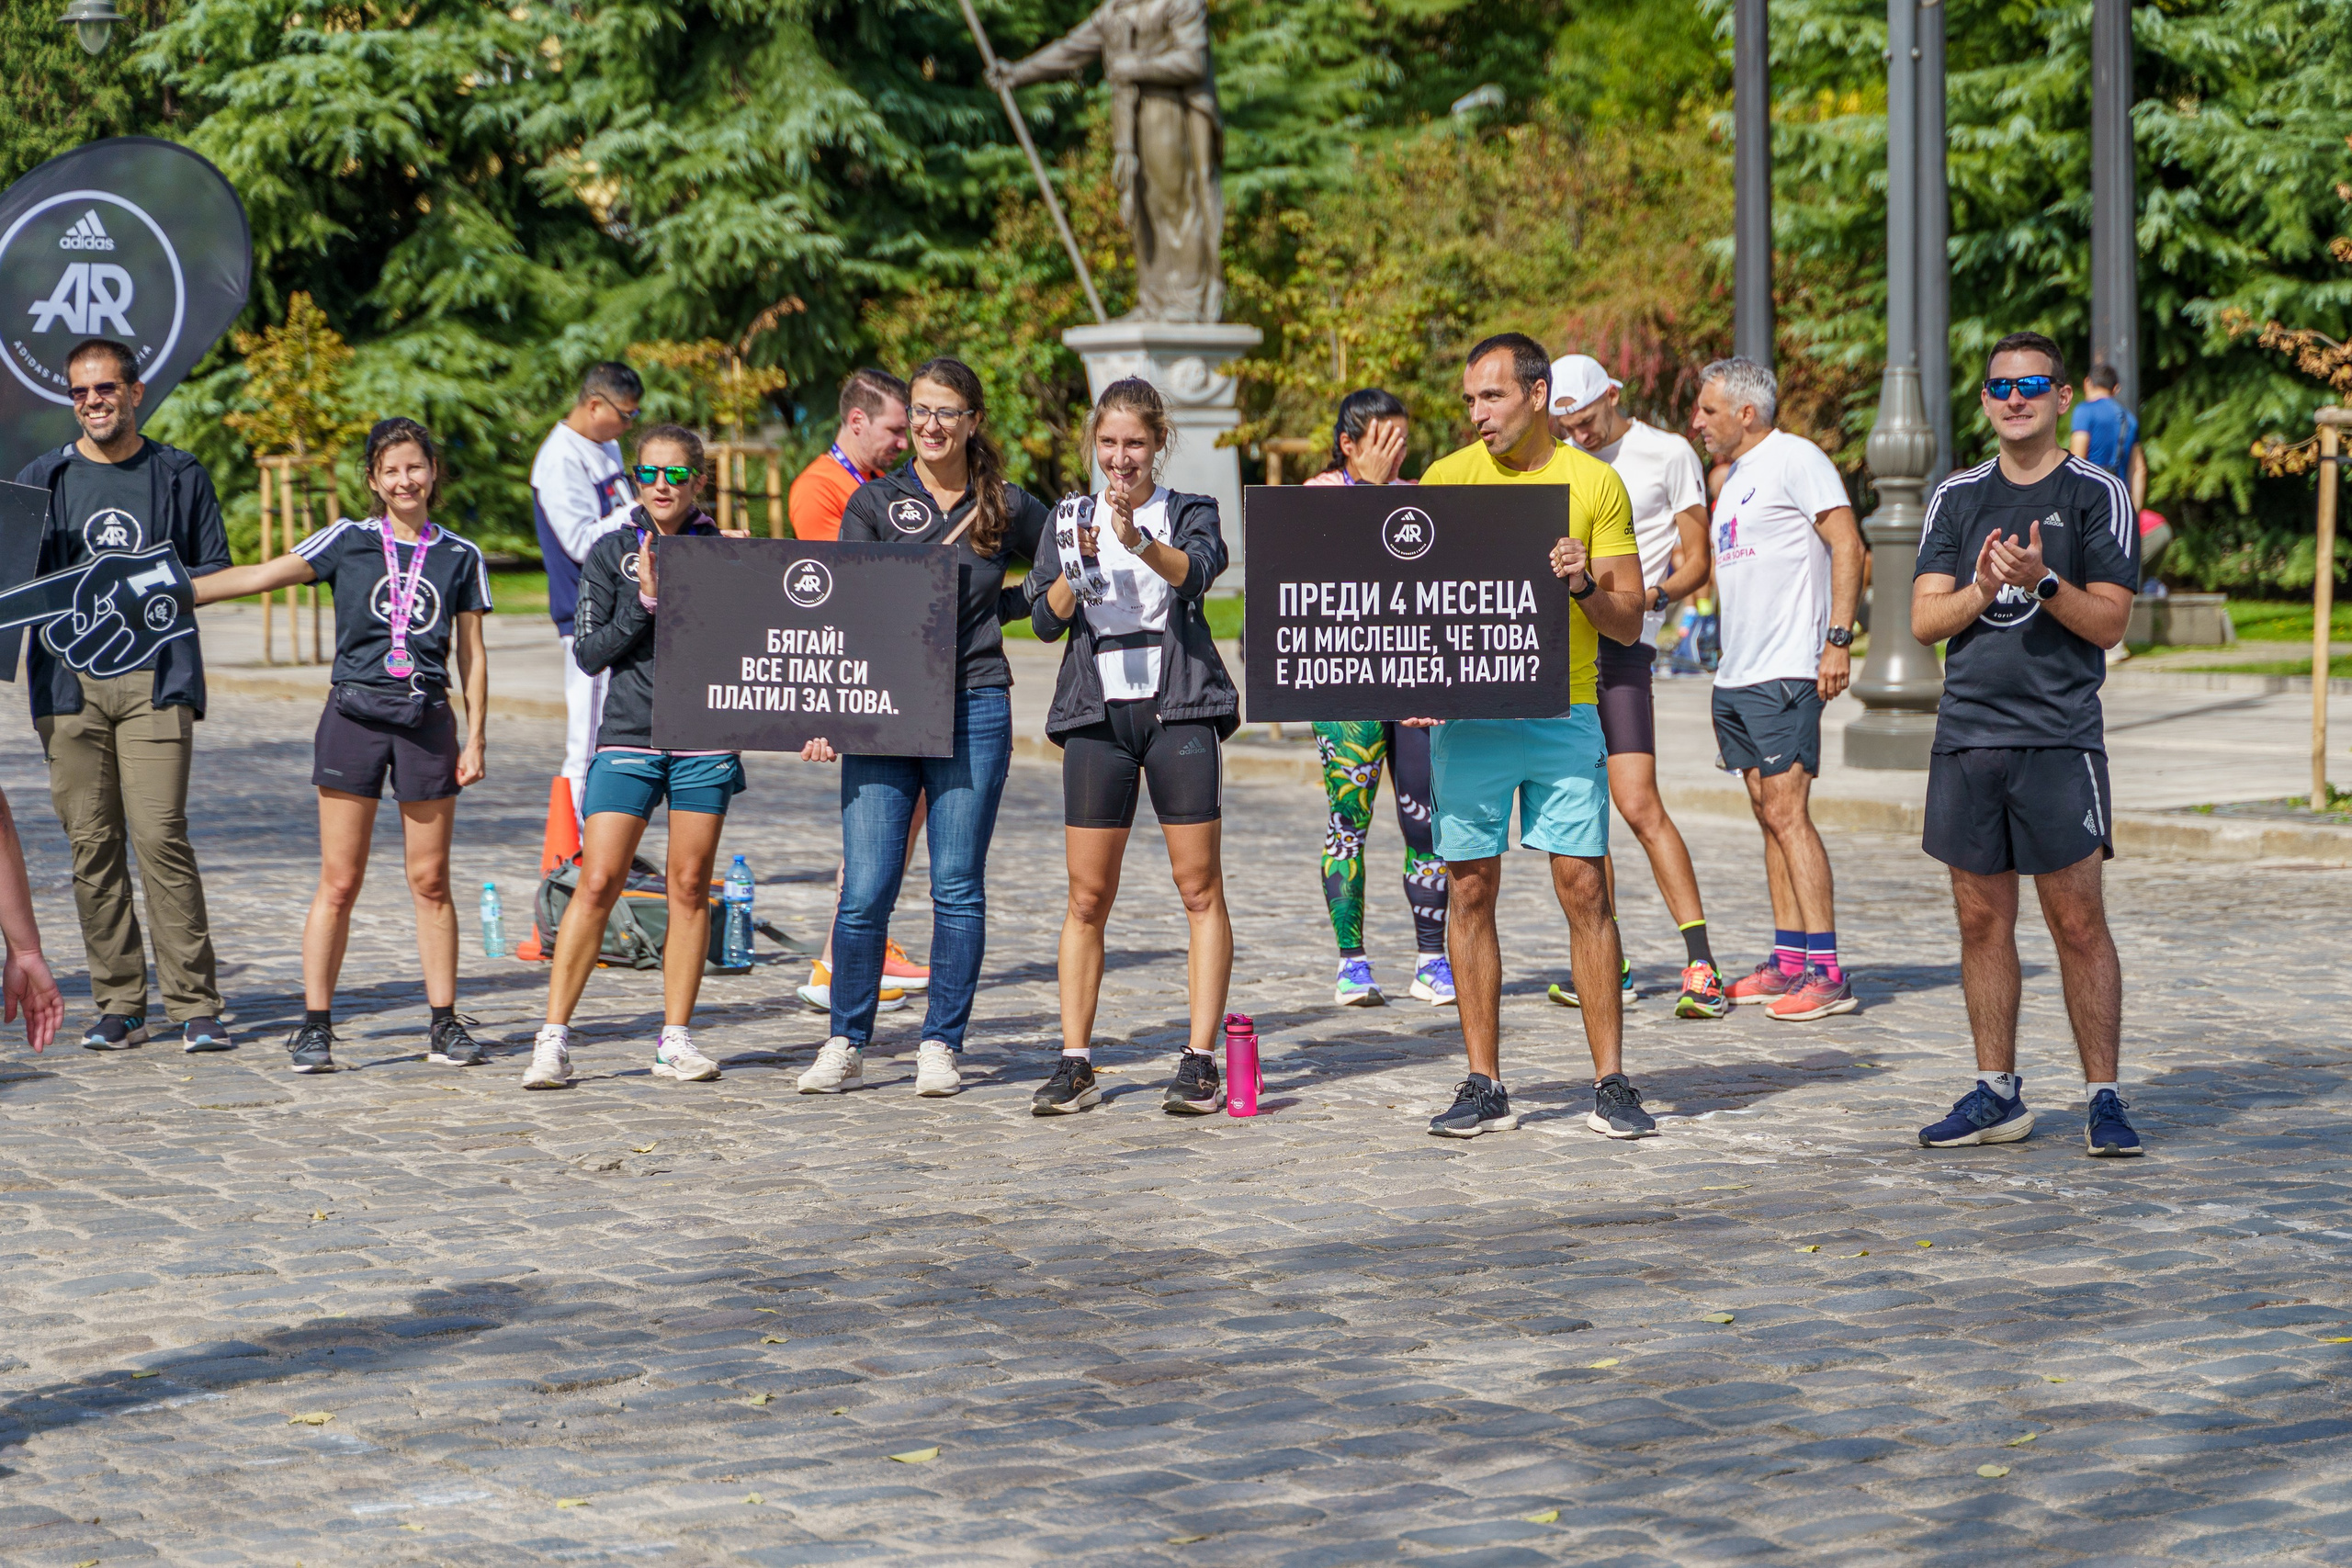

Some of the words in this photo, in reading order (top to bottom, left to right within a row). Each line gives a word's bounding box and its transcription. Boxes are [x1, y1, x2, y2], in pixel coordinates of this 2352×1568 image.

[59, 235, 115, 251] adidas
[28, 262, 135, 336] AR
[13, 340, 50, 378] ADIDAS
[96, 525, 129, 547] AR
[1393, 524, 1422, 542] AR
[2043, 519, 2064, 527] adidas
[1732, 547, 1756, 559] SOFIA
[794, 574, 821, 592] AR
[1279, 581, 1380, 621] ПРЕДИ
[1389, 581, 1407, 615] 4
[1416, 580, 1538, 620] МЕСЕЦА
[1993, 611, 2014, 619] SOFIA
[766, 625, 844, 656] БЯГАЙ!
[1276, 626, 1306, 653] СИ
[1315, 625, 1438, 656] МИСЛЕШЕ,
[1445, 625, 1474, 651] ЧЕ
[1479, 624, 1540, 650] ТОВА
[741, 656, 783, 682] ВСЕ
[788, 658, 833, 684] ПАК
[838, 660, 868, 685] СИ
[1276, 658, 1289, 685] Е
[1295, 657, 1375, 689] ДОБРА
[1381, 656, 1453, 687] ИДЕЯ,
[1459, 655, 1540, 682] НАЛИ?
[707, 684, 797, 712] ПЛАТИЛ
[801, 687, 831, 713] ЗА
[835, 688, 899, 715] ТОВА.
[1179, 747, 1206, 756] adidas
[2086, 808, 2098, 836] adidas
